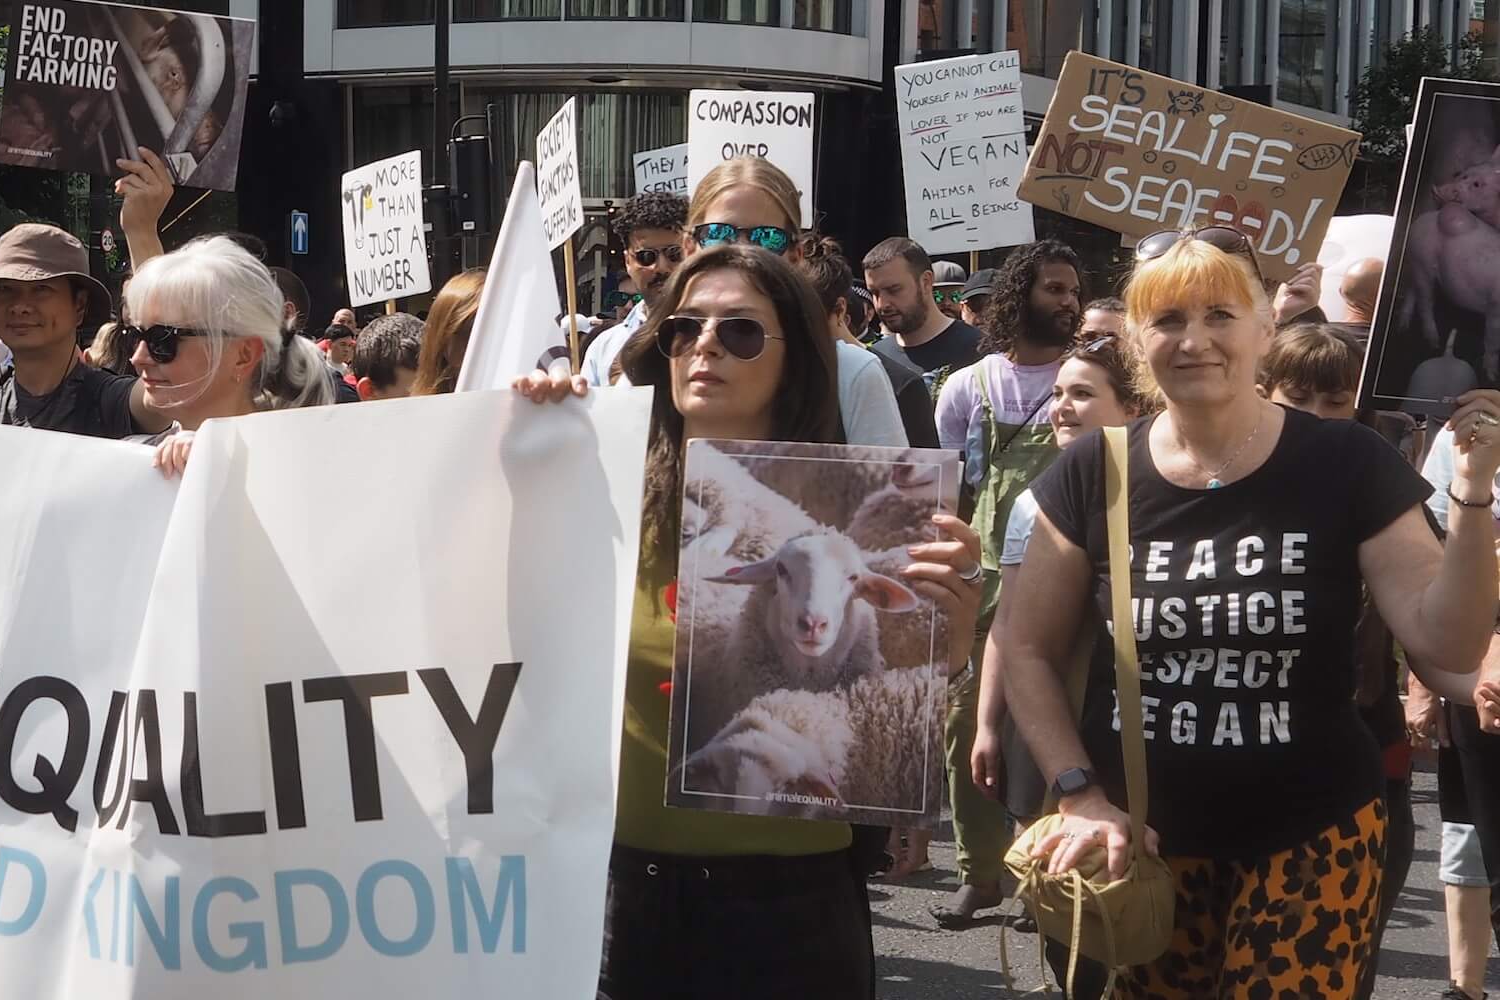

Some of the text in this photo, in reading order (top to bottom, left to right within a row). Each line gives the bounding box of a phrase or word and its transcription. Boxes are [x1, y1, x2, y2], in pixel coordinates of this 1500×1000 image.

[22, 4, 66, 33] END
[19, 30, 118, 65] FACTORY
[16, 55, 117, 90] FARMING
[902, 57, 1019, 96] YOU CANNOT CALL
[1088, 68, 1146, 106] IT'S
[904, 82, 1017, 111] YOURSELF AN ANIMAL
[697, 99, 812, 128] COMPASSION
[910, 105, 1017, 131] LOVER IF YOU ARE
[539, 103, 571, 171] SOCIETY
[722, 142, 768, 161] OVER
[921, 131, 949, 147] NOT
[636, 157, 674, 180] THEY
[920, 140, 1019, 171] VEGAN
[1036, 132, 1124, 178] NOT
[375, 160, 415, 188] MORE
[922, 176, 1010, 201] AHIMSA FOR
[378, 192, 416, 217] THAN
[929, 201, 1019, 221] ALL BEINGS
[103, 235, 112, 246] 20
[369, 225, 423, 258] JUST A
[354, 259, 415, 297] NUMBER
[1128, 533, 1308, 582] EACE
[1136, 648, 1301, 689] ESPECT
